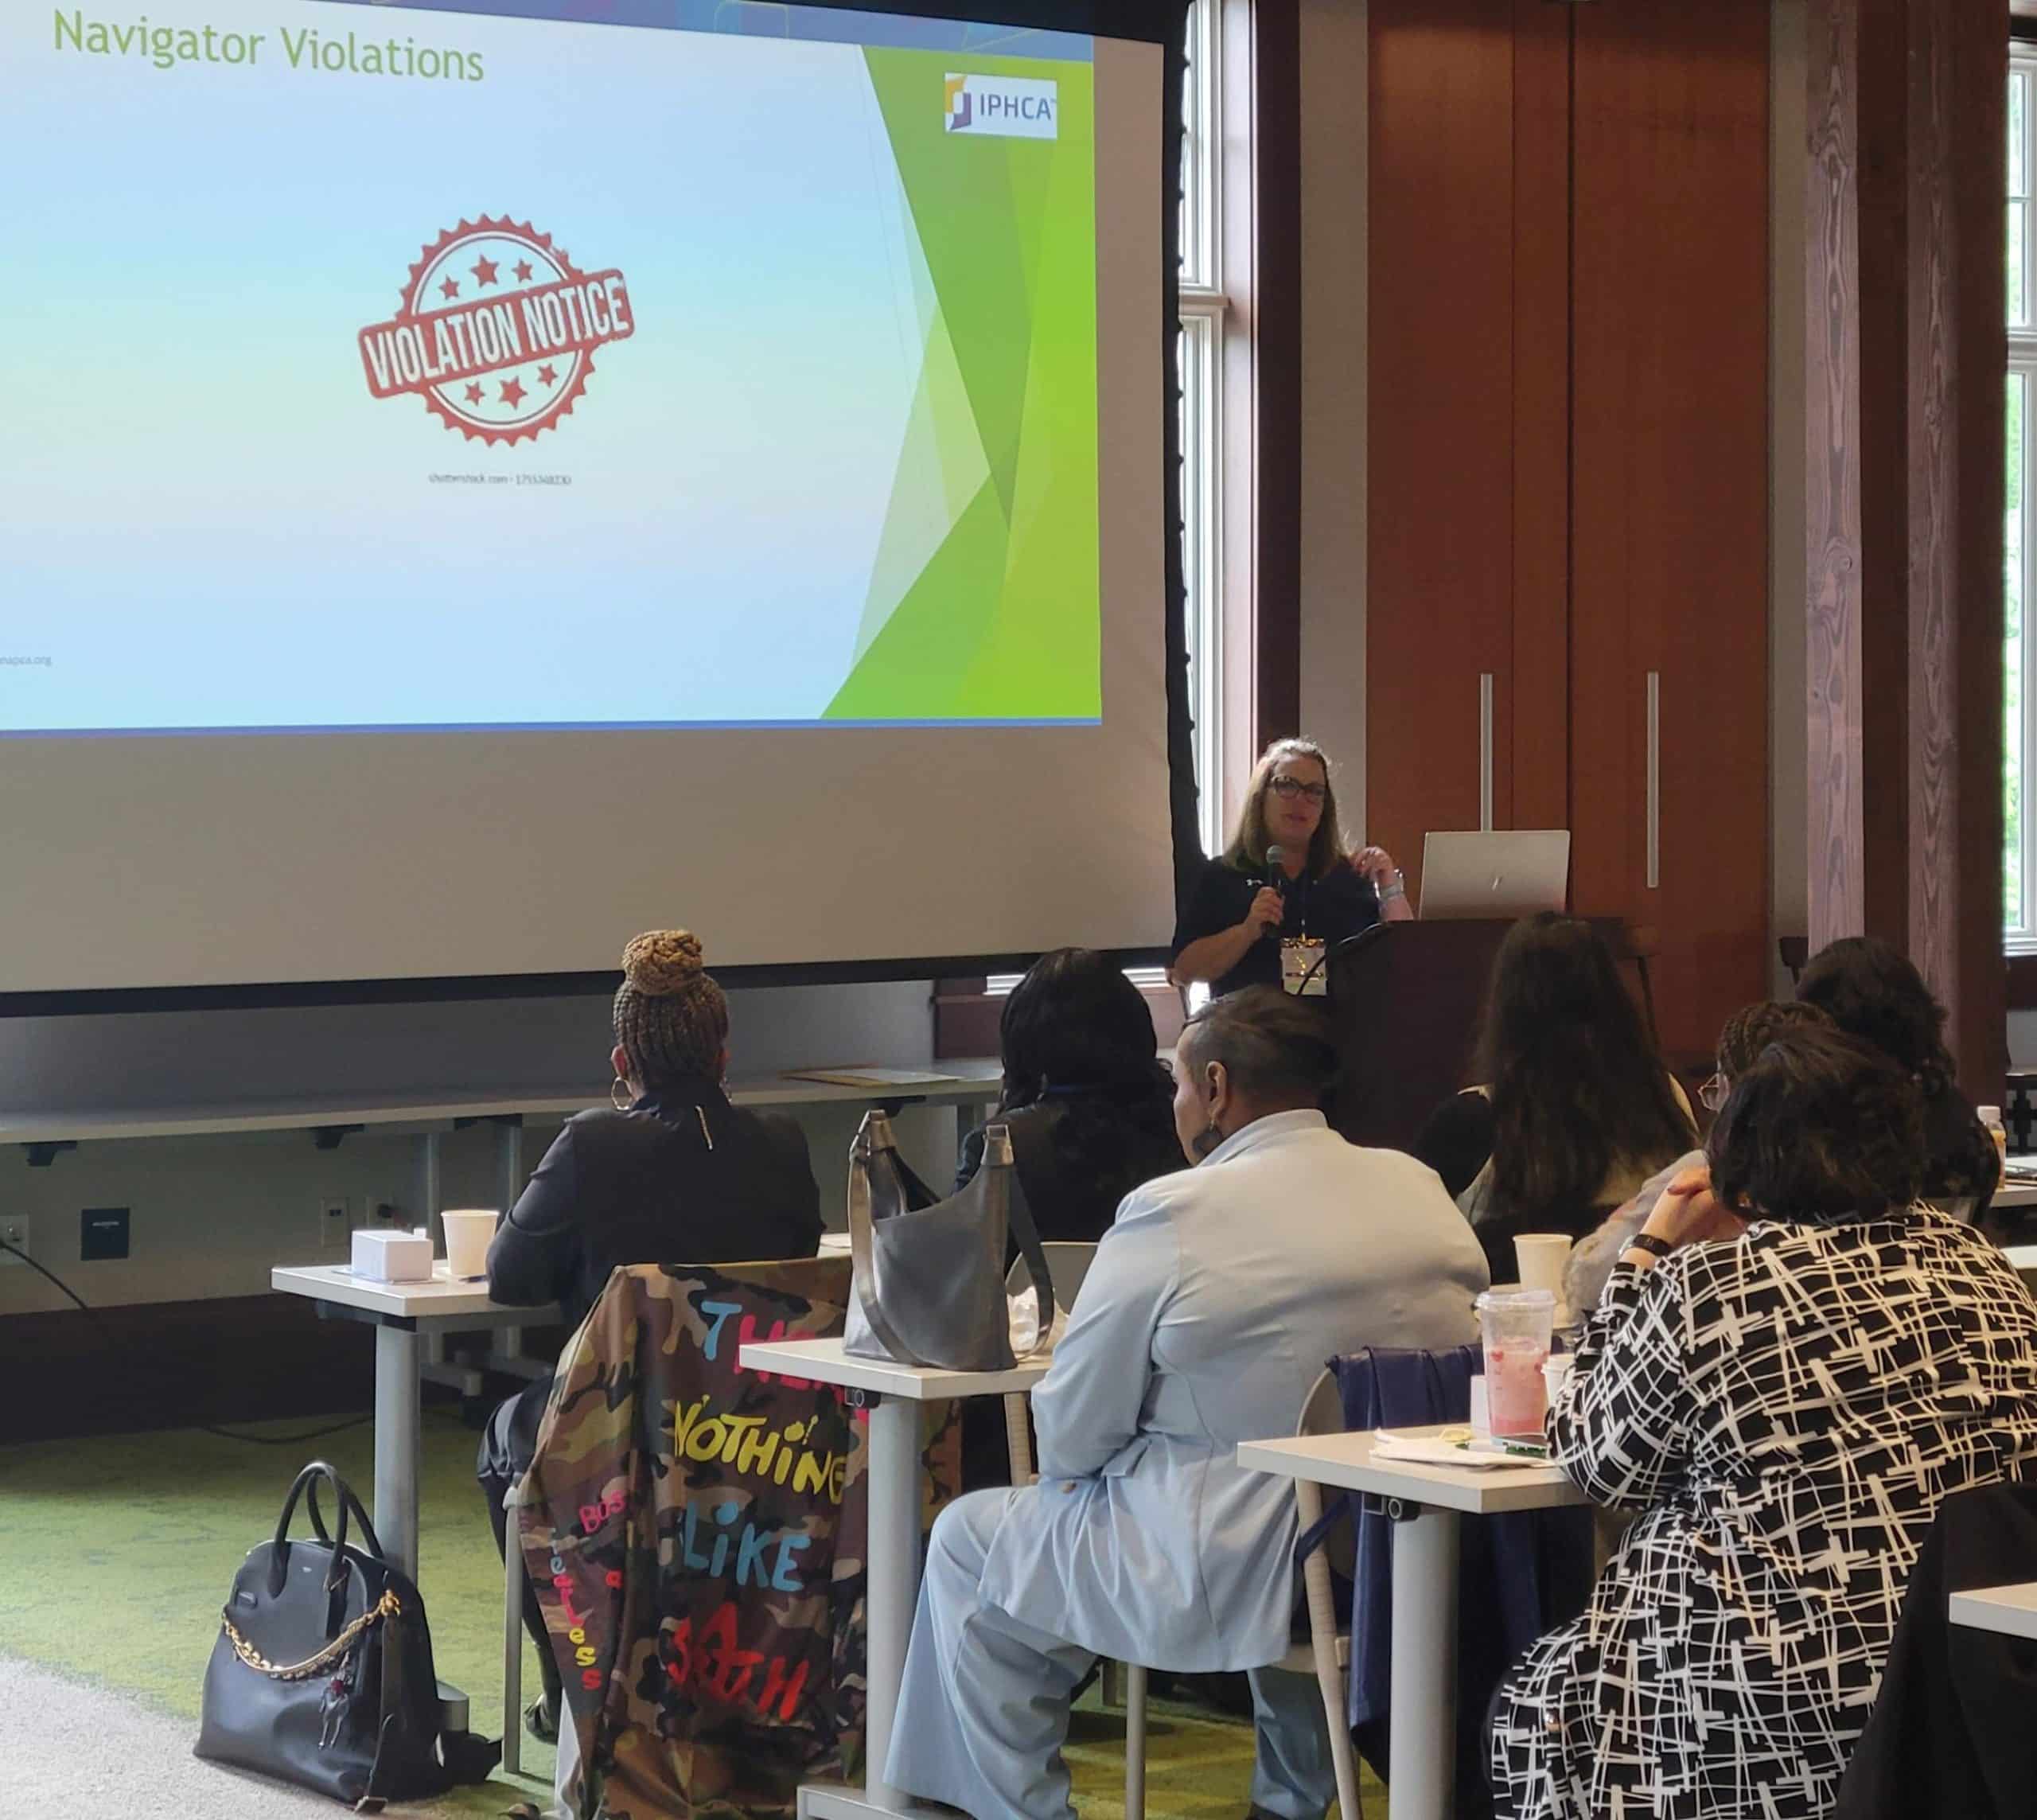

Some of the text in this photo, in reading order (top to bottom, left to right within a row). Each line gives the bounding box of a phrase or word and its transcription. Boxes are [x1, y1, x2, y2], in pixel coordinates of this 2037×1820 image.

[53, 10, 485, 81] Navigator Violations
[980, 93, 1051, 120] IPHCA
[364, 277, 629, 390] VIOLATION NOTICE
